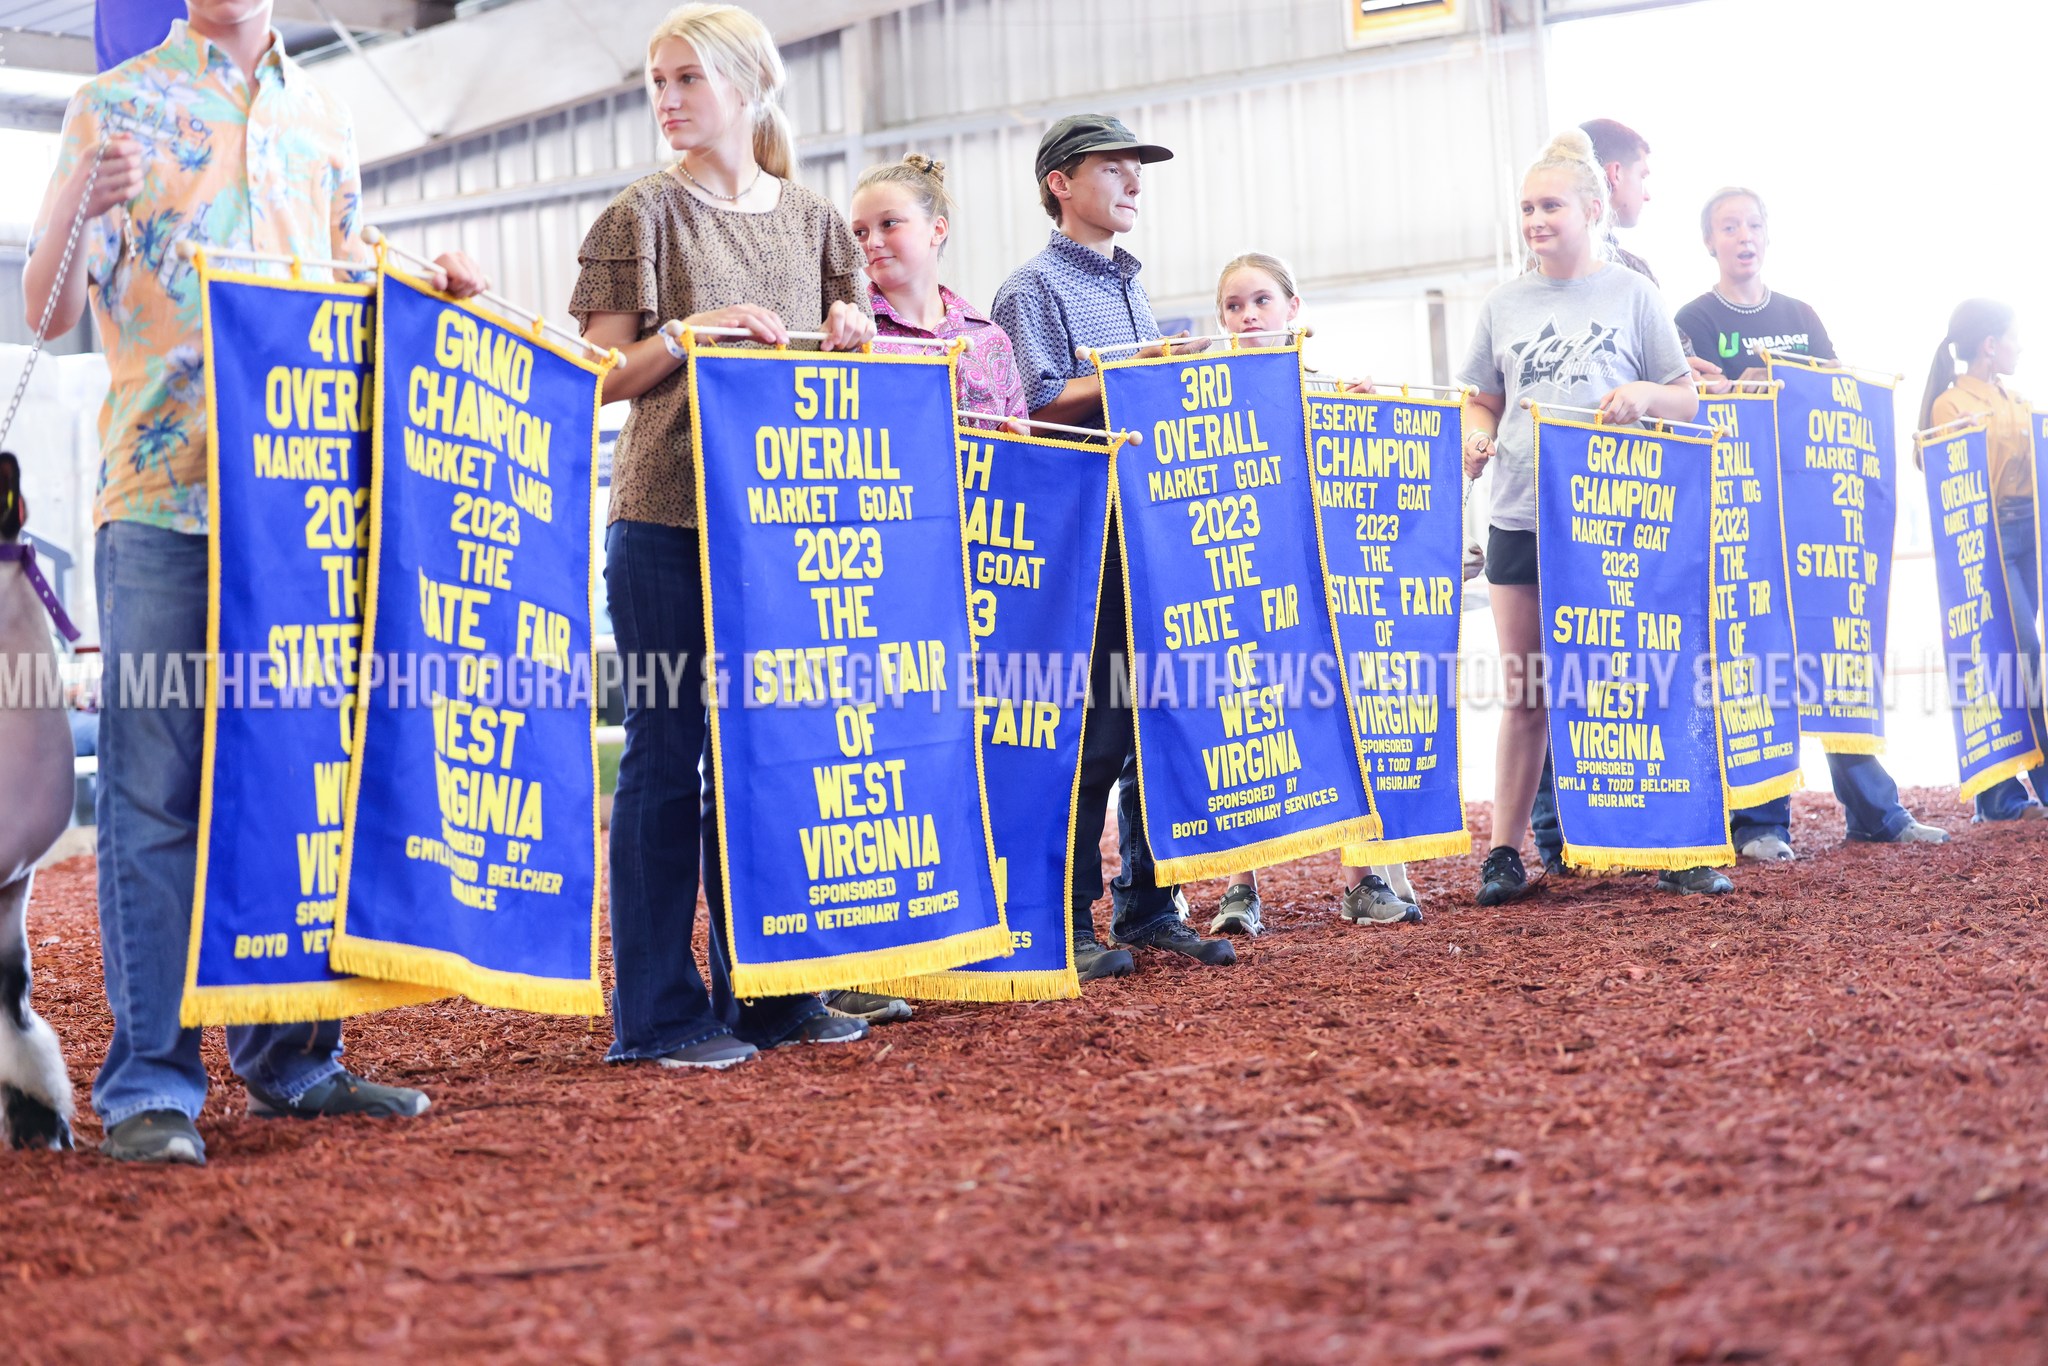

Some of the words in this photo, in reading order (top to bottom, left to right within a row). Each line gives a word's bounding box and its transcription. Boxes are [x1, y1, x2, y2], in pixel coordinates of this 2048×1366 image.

[308, 299, 374, 364] 4TH
[435, 309, 534, 404] GRAND
[794, 367, 859, 420] 5TH
[1180, 363, 1233, 411] 3RD
[408, 365, 552, 477] CHAMPION
[1153, 410, 1268, 465] OVERALL
[1393, 408, 1441, 437] GRAND
[1809, 409, 1876, 453] OVERALL
[253, 434, 351, 481] MARKET
[755, 426, 900, 480] OVERALL
[1316, 436, 1430, 479] CHAMPION
[1587, 435, 1663, 479] GRAND
[1716, 442, 1754, 477] ERALL
[1946, 438, 1969, 473] 3RD
[507, 465, 552, 523] LAMB
[1148, 464, 1218, 502] MARKET
[1234, 456, 1282, 490] GOAT
[1397, 484, 1432, 511] GOAT
[1570, 475, 1676, 522] CHAMPION
[1940, 469, 1987, 511] OVERALL
[304, 486, 370, 549] 202
[450, 492, 520, 546] 2023
[747, 486, 838, 523] MARKET
[858, 485, 913, 520] GOAT
[1188, 494, 1261, 546] 2023
[1356, 514, 1399, 541] 2023
[1572, 516, 1625, 546] MARKET
[1633, 524, 1670, 552] GOAT
[1956, 528, 1986, 567] 2023
[457, 540, 514, 591] THE
[794, 527, 884, 582] 2023
[976, 551, 1046, 590] GOAT
[1204, 543, 1261, 592] THE
[1360, 546, 1393, 572] THE
[1602, 551, 1639, 578] 2023
[1721, 546, 1748, 581] THE
[1797, 543, 1859, 579] STATE
[321, 556, 366, 617] TH
[1329, 574, 1387, 616] STATE
[1399, 576, 1454, 615] FAIR
[1607, 580, 1635, 607] THE
[1748, 580, 1771, 616] FAIR
[1849, 582, 1866, 615] OF
[1963, 562, 1984, 599] THE
[811, 585, 878, 640] THE
[1163, 595, 1239, 651] STATE
[1260, 584, 1299, 633] FAIR
[1374, 620, 1394, 646] OF
[1553, 605, 1625, 648] STATE
[1638, 611, 1681, 651] FAIR
[1948, 599, 1979, 640] STATE
[516, 600, 571, 675] FAIR
[1729, 622, 1746, 657] OF
[1832, 617, 1871, 652] WES
[268, 624, 357, 689] STATE
[459, 655, 499, 699] OF
[754, 645, 852, 704] STATE
[878, 639, 947, 695] FAIR
[1226, 641, 1258, 689] OF
[1358, 651, 1420, 690] WEST
[1611, 652, 1631, 677] OF
[1720, 658, 1755, 696] WEST
[1219, 683, 1285, 739] WEST
[1355, 694, 1438, 734] VIRGINIA
[1587, 680, 1649, 719] WEST
[1721, 694, 1775, 735] VIRGINIA
[835, 703, 878, 757] OF
[976, 695, 1060, 750] FAIR
[1569, 721, 1665, 761] VIRGINIA
[1202, 729, 1302, 791] VIRGINIA
[1361, 738, 1413, 753] SPONSORED
[1377, 758, 1385, 772] &
[1388, 758, 1410, 772] TODD
[1376, 775, 1421, 790] INSURANCE
[1576, 760, 1634, 775] SPONSORED
[1647, 763, 1660, 776] BY
[1592, 778, 1600, 791] &
[1608, 778, 1634, 792] TODD
[1640, 779, 1690, 792] BELCHER
[813, 759, 906, 819] WEST
[1207, 783, 1275, 813] SPONSORED
[1286, 777, 1298, 794] BY
[1588, 794, 1645, 807] INSURANCE
[1172, 822, 1208, 839] BOYD
[1216, 805, 1282, 832] VETERINARY
[1284, 787, 1339, 815] SERVICES
[506, 840, 531, 864] BY
[799, 813, 941, 880] VIRGINIA
[486, 863, 564, 895] BELCHER
[809, 876, 896, 906] SPONSORED
[917, 871, 935, 892] BY
[762, 913, 807, 936] BOYD
[815, 901, 900, 931] VETERINARY
[908, 890, 959, 918] SERVICES
[234, 933, 288, 958] BOYD
